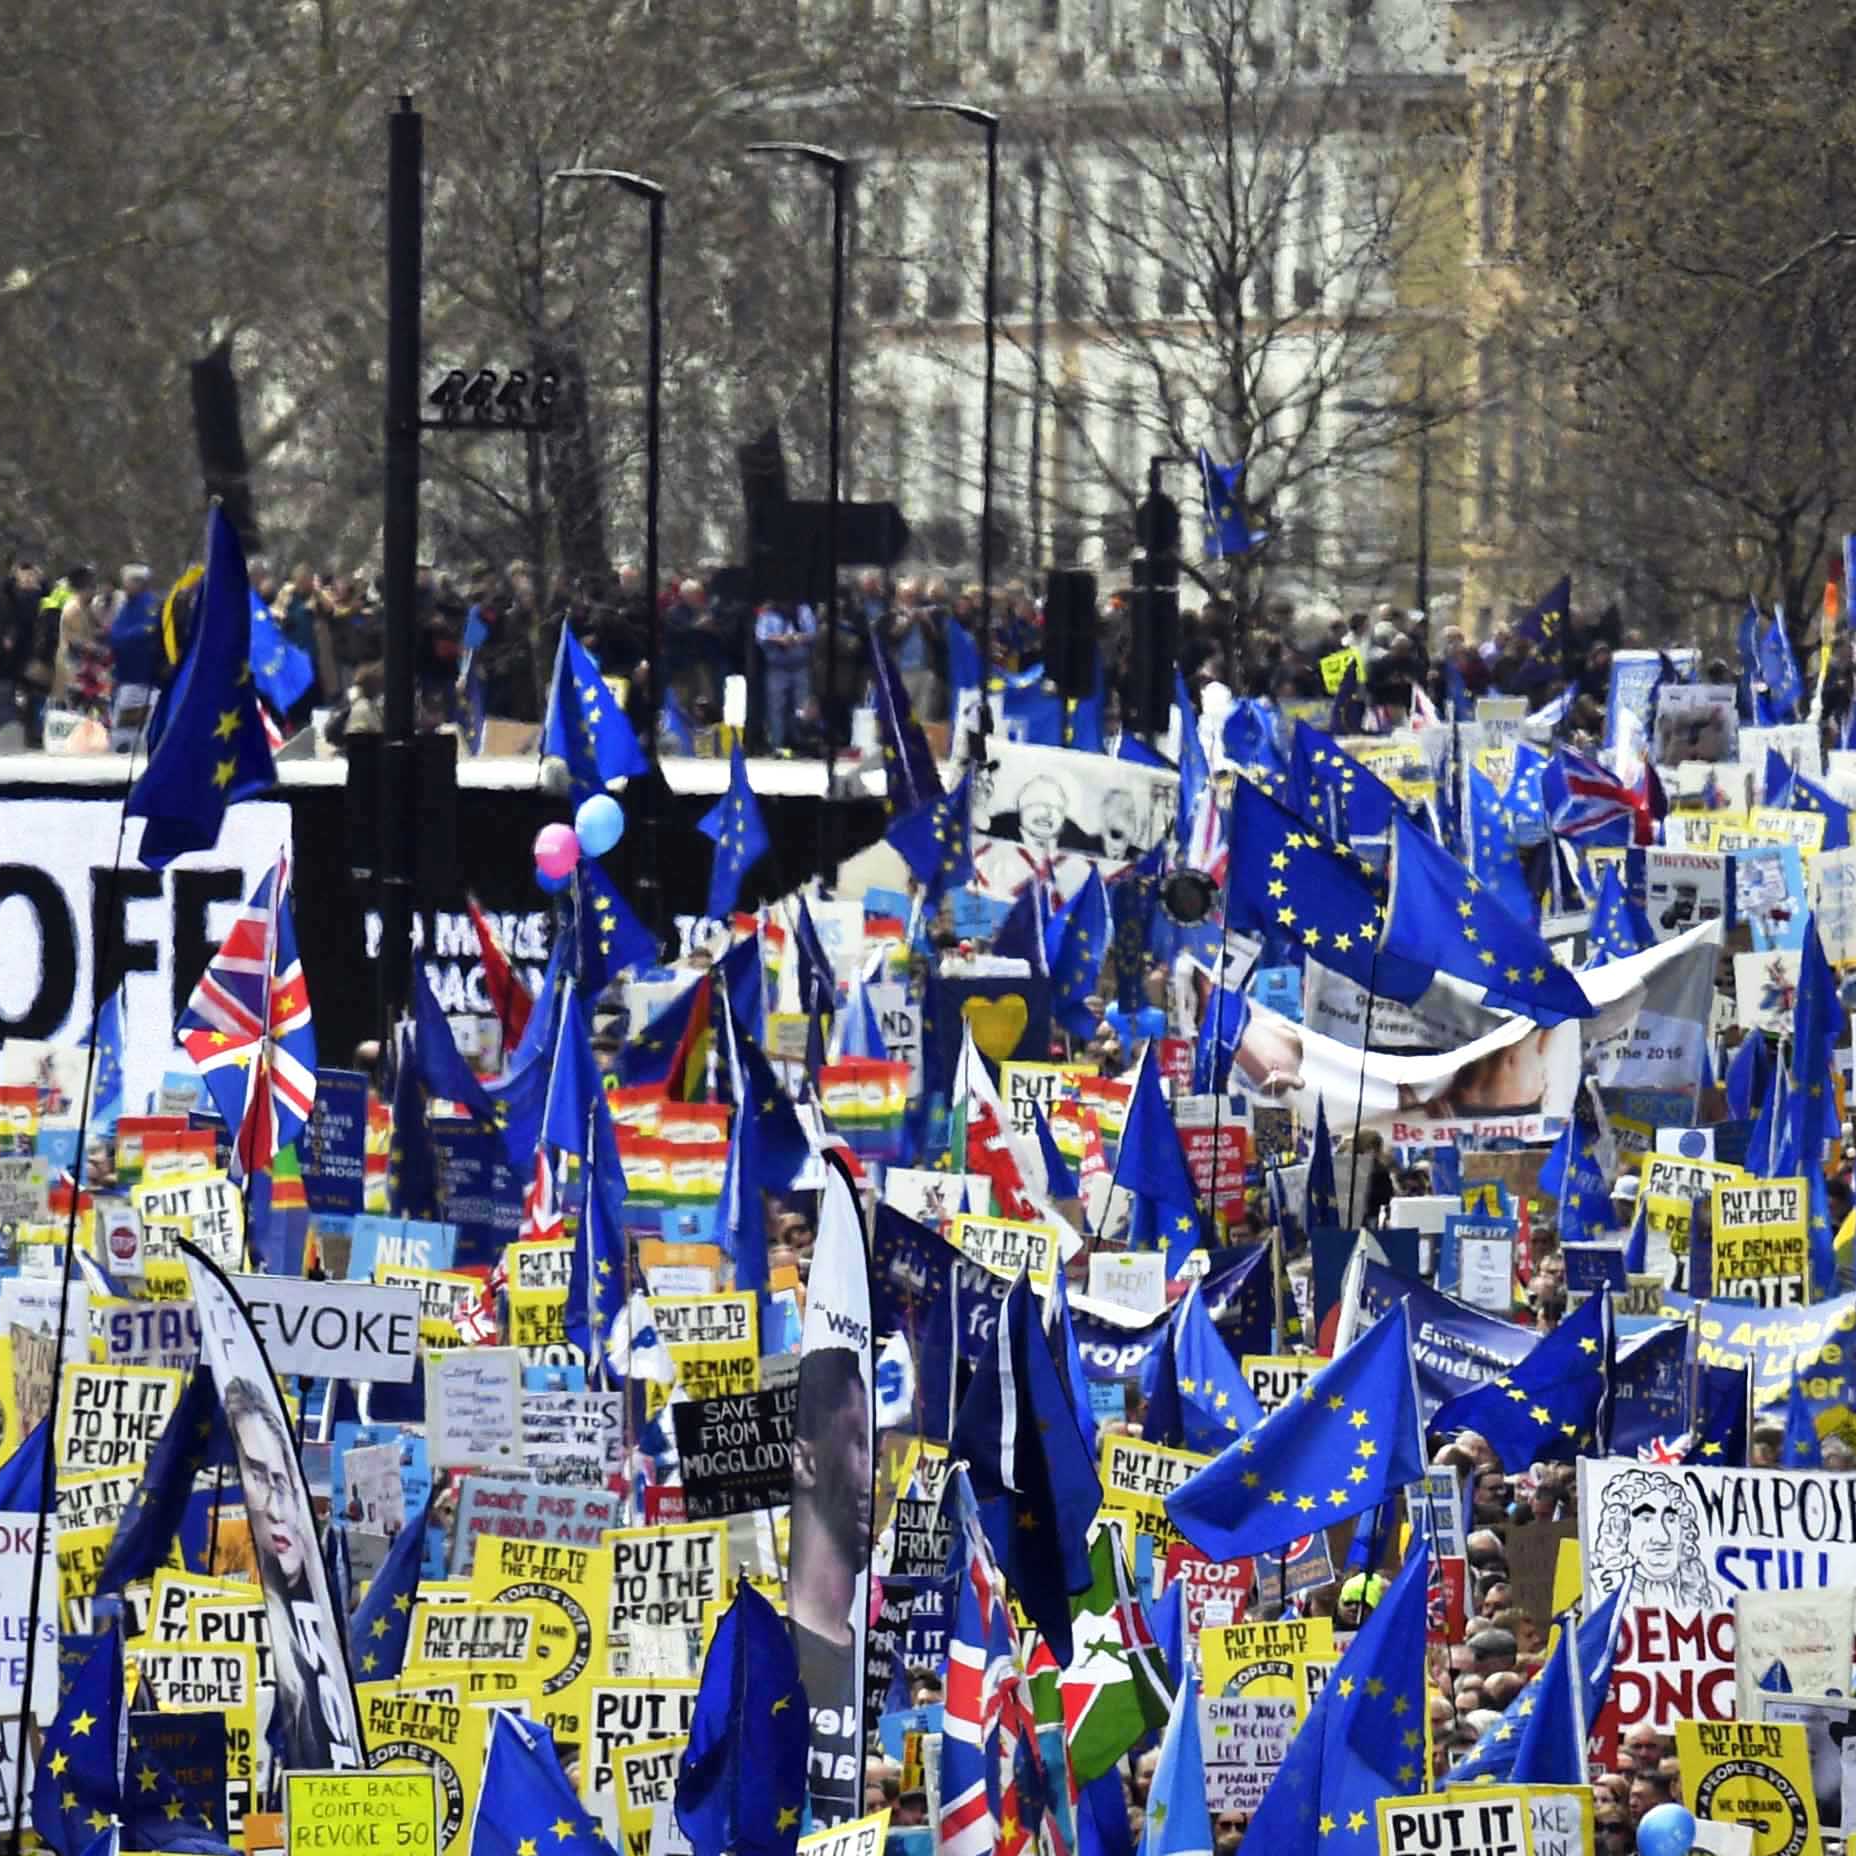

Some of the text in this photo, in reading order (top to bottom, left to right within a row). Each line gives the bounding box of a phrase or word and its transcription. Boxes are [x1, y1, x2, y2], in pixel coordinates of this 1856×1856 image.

[1652, 853, 1722, 872] BRITONS
[377, 1238, 432, 1268] NHS
[1717, 1260, 1729, 1275] A
[250, 1303, 413, 1357] EVOKE
[704, 1398, 760, 1424] SAVE
[700, 1424, 760, 1448] FROM
[1179, 1559, 1239, 1583] STOP
[303, 1781, 422, 1798] TAKE BACK
[312, 1801, 402, 1818] CONTROL
[295, 1822, 430, 1848] REVOKE 50
